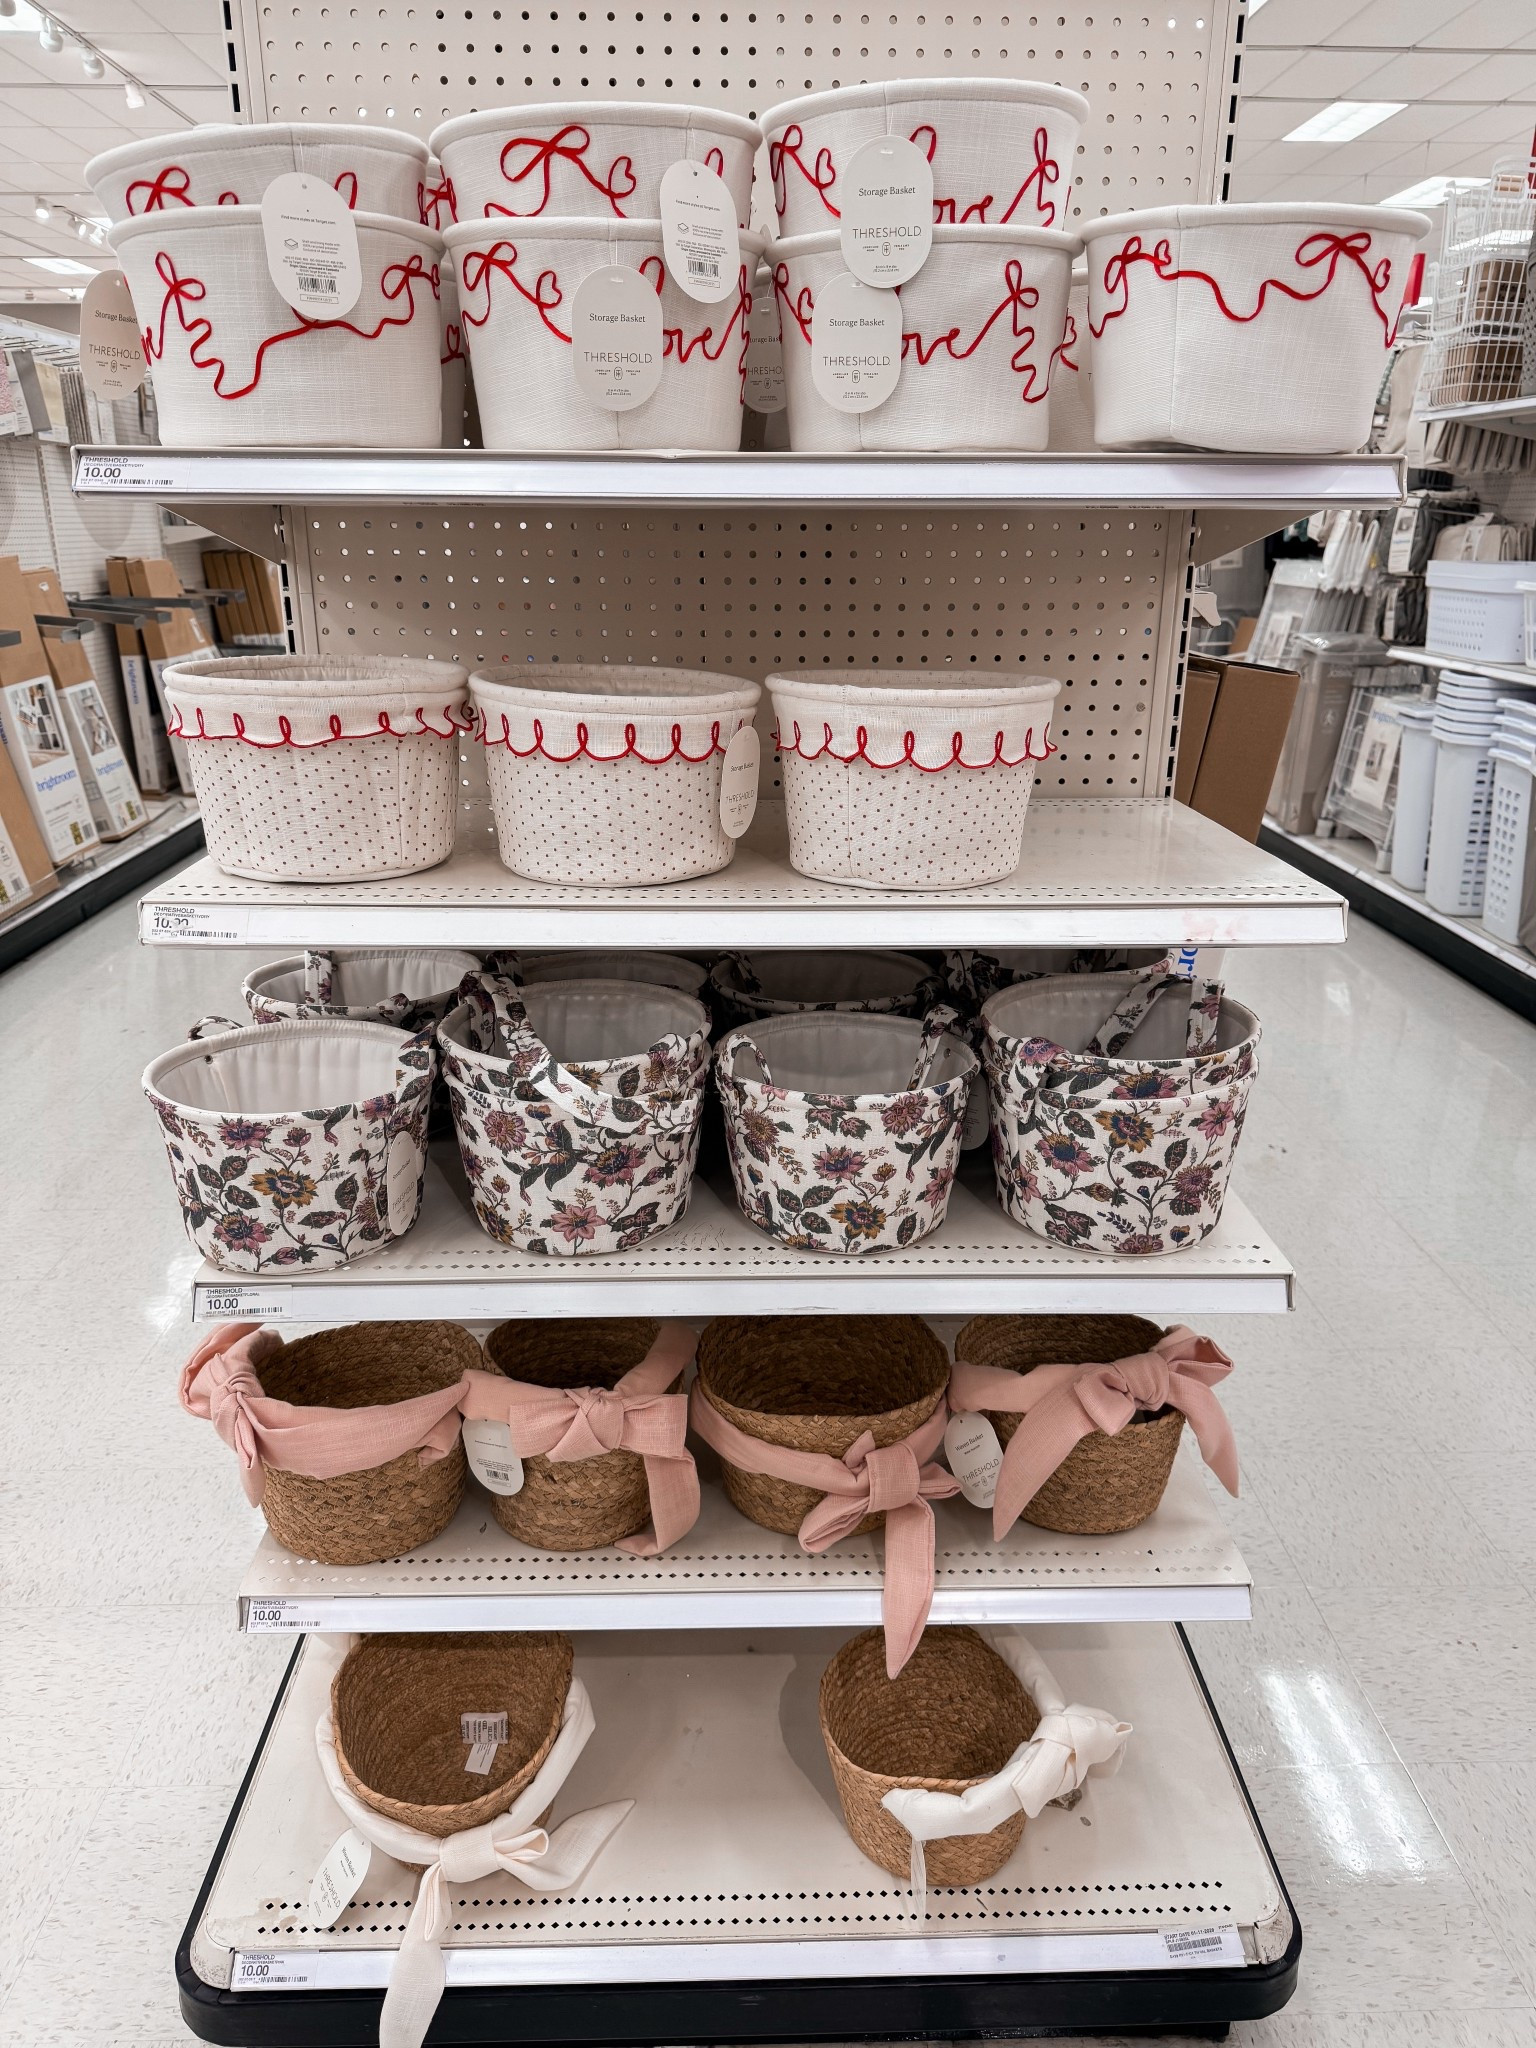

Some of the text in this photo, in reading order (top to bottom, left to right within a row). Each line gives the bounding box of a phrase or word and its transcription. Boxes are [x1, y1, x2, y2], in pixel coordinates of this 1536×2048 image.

[858, 186, 916, 197] Storage Basket
[852, 226, 922, 239] THRESHOLD
[95, 309, 117, 321] Storage
[589, 313, 646, 323] Storage Basket
[829, 318, 885, 328] Storage Basket
[750, 336, 767, 344] torage
[89, 344, 140, 360] THRESHOLD
[583, 351, 653, 364] THRESHOLD
[823, 355, 891, 366] THRESHOLD
[748, 366, 782, 375] HRESHO
[84, 456, 129, 464] THRESHOLD
[84, 467, 121, 478] 10.00
[154, 906, 195, 914] THRESHOLD
[207, 1298, 239, 1310] 10.00
[962, 1458, 1000, 1483] THRESHOLD
[253, 1610, 281, 1621] 10.00
[241, 1965, 269, 1976] 10.00
